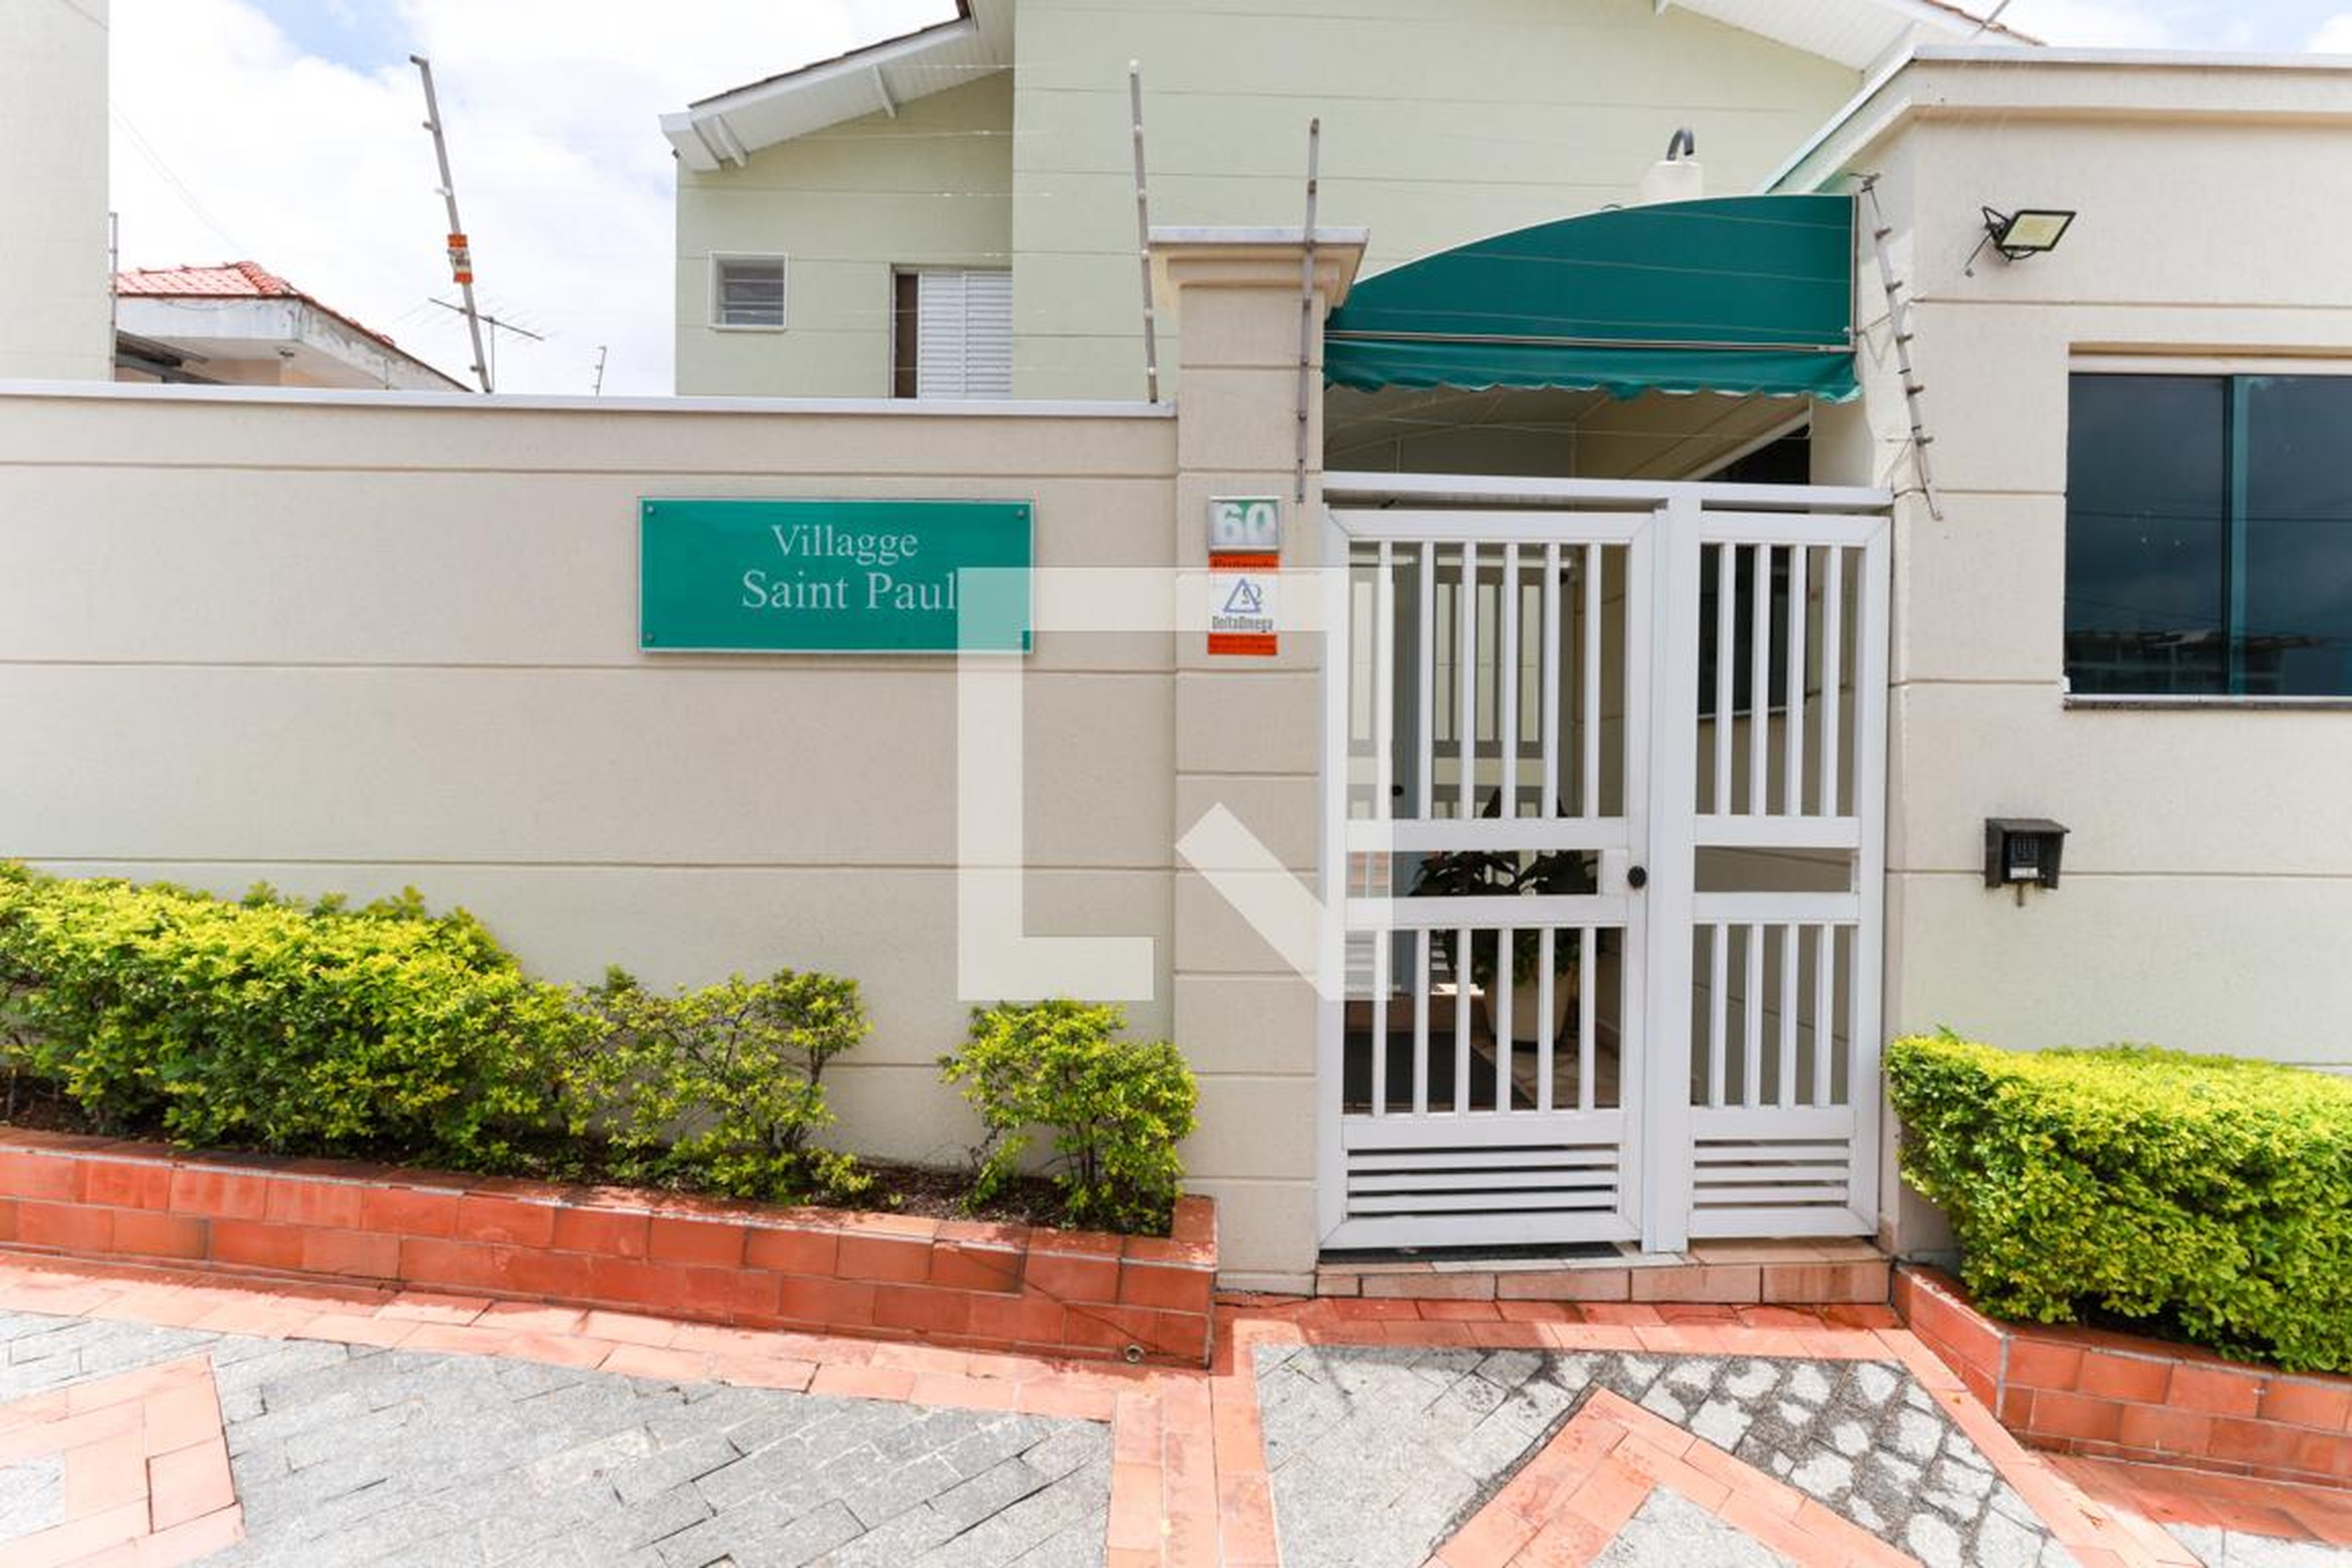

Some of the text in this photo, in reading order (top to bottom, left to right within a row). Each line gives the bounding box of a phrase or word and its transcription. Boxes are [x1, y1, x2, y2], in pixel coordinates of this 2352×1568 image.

[1215, 501, 1276, 544] 60
[772, 524, 918, 566] Villagge
[742, 570, 957, 611] Saint Paul
